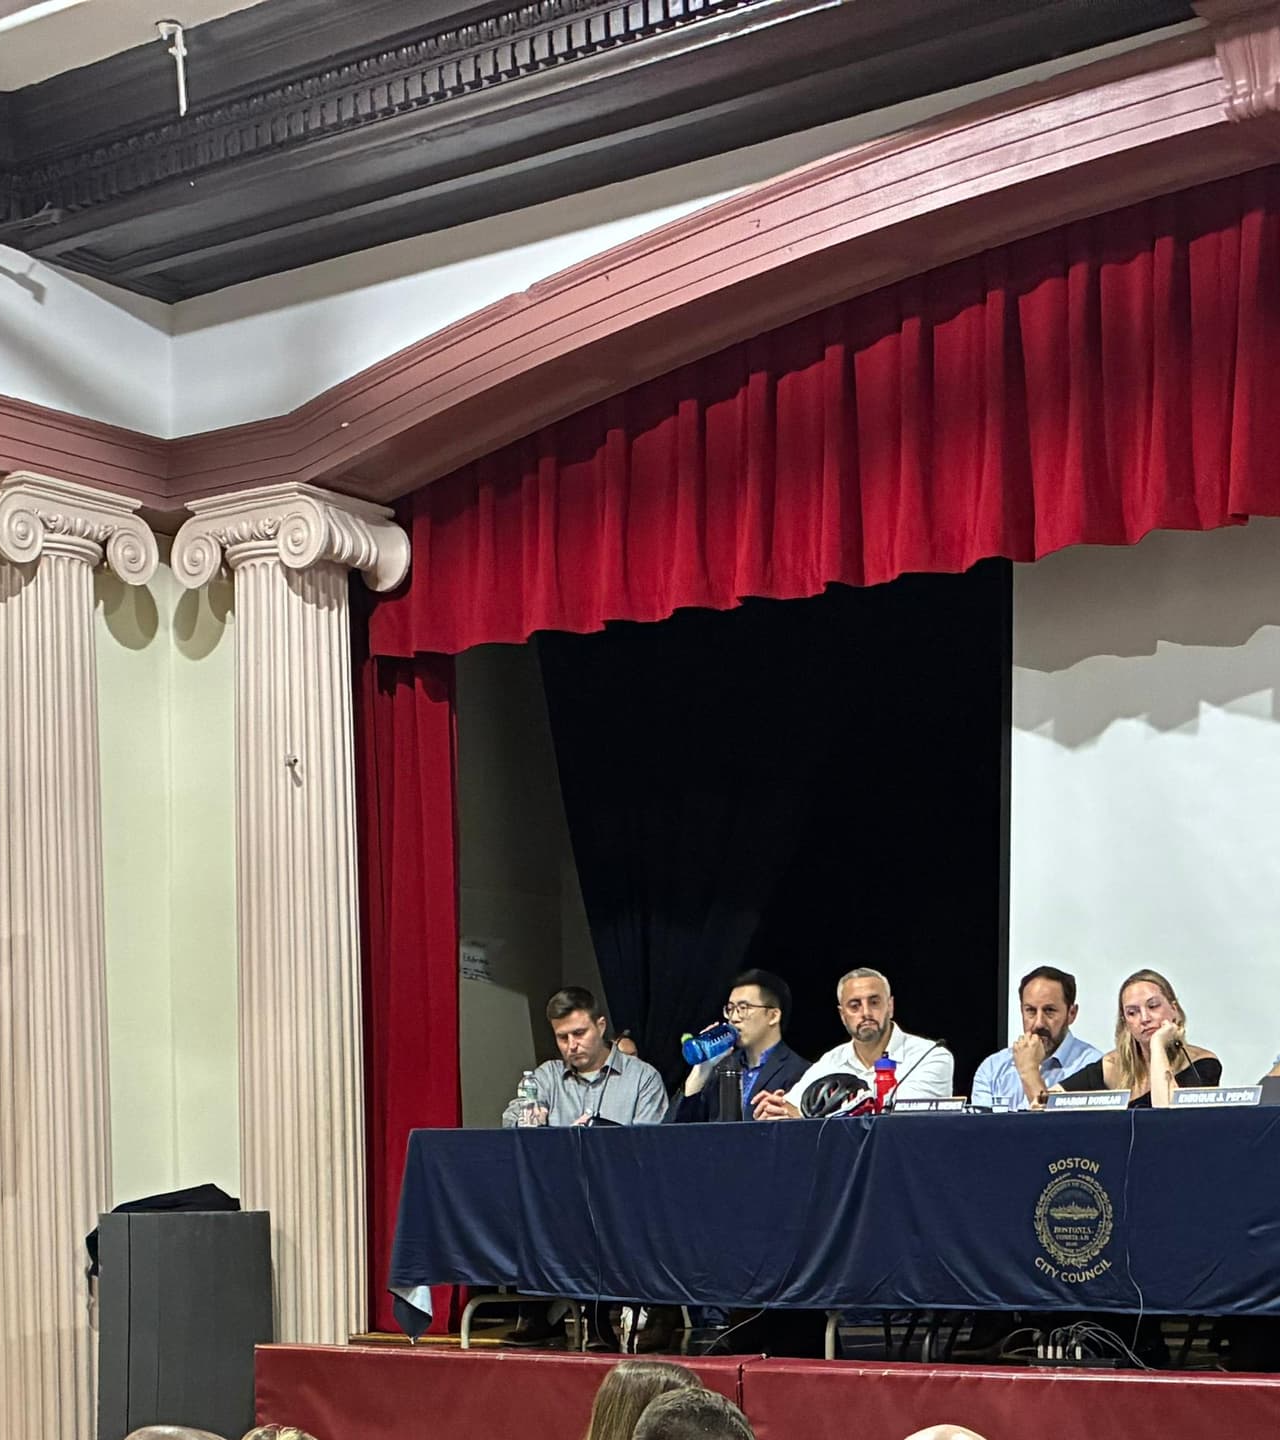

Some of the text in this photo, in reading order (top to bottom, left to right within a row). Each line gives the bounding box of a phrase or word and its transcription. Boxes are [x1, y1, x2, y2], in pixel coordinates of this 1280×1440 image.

[1048, 1157, 1100, 1174] BOSTON
[1034, 1257, 1113, 1283] CITY COUNCIL
